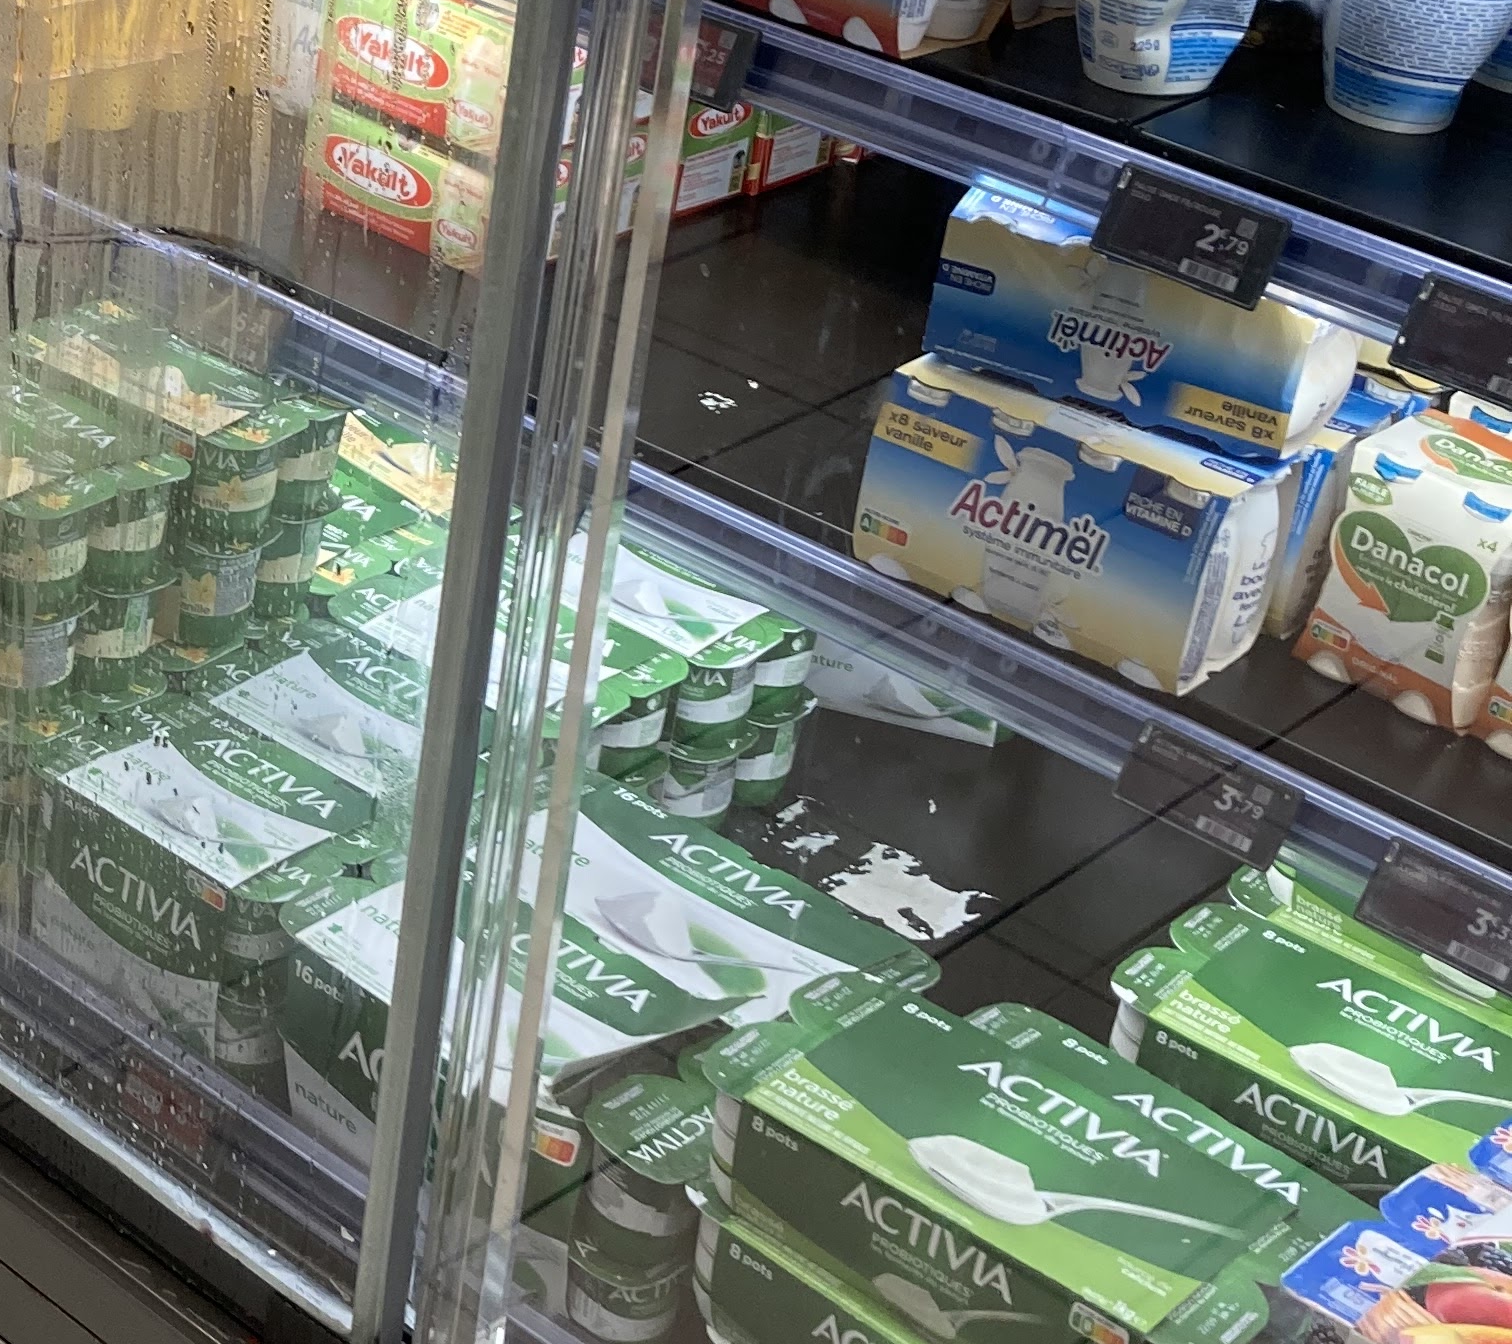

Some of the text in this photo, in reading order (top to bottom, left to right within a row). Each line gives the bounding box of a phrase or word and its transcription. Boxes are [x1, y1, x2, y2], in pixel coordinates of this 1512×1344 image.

[356, 32, 431, 77] Yaklt
[340, 148, 411, 201] Yakult
[1050, 310, 1172, 371] Actimel
[888, 411, 968, 449] x8 saveur
[1185, 405, 1275, 441] x8 saveur
[1221, 399, 1278, 426] vanille
[885, 423, 934, 453] vanille
[952, 482, 1106, 570] Actimel
[1125, 503, 1179, 535] VITAMINE
[1165, 504, 1185, 520] EN
[962, 523, 1082, 581] système immunitaire
[1350, 524, 1470, 598] Danacol
[1476, 536, 1499, 554] x4
[335, 655, 425, 699] ACTI
[812, 654, 855, 673] ature
[193, 737, 340, 820] ACTIVIA
[612, 785, 668, 820] 16 pots
[648, 831, 808, 920] ACTIVIA
[659, 855, 756, 907] PROBIOTIQUES
[69, 844, 201, 953] ACTIVIA
[1262, 928, 1306, 954] 8 pots
[295, 958, 313, 986] 16
[901, 1002, 953, 1032] 8 pots
[1170, 998, 1232, 1035] nature
[1178, 989, 1241, 1026] brassé
[1315, 977, 1496, 1073] ACTIVIA
[1061, 1036, 1109, 1066] 8 pots
[1156, 1030, 1199, 1061] 8 pots
[1342, 1005, 1450, 1061] PROBIOTIQUES
[294, 1080, 358, 1135] nature
[769, 1078, 840, 1122] nature
[783, 1067, 856, 1112] brassé
[626, 1105, 716, 1165] ACTIVIA
[751, 1115, 799, 1152] 8 pots
[957, 1060, 1162, 1179] ACTIVIA
[985, 1092, 1106, 1162] PROBIOTIQUES
[1233, 1082, 1389, 1179] ACTIVIA
[1112, 1093, 1302, 1205] ACTIVIA
[728, 1243, 774, 1282] 8 pots
[839, 1181, 1014, 1306] ACTIVIA
[871, 1232, 975, 1299] PROBIOTIQUES
